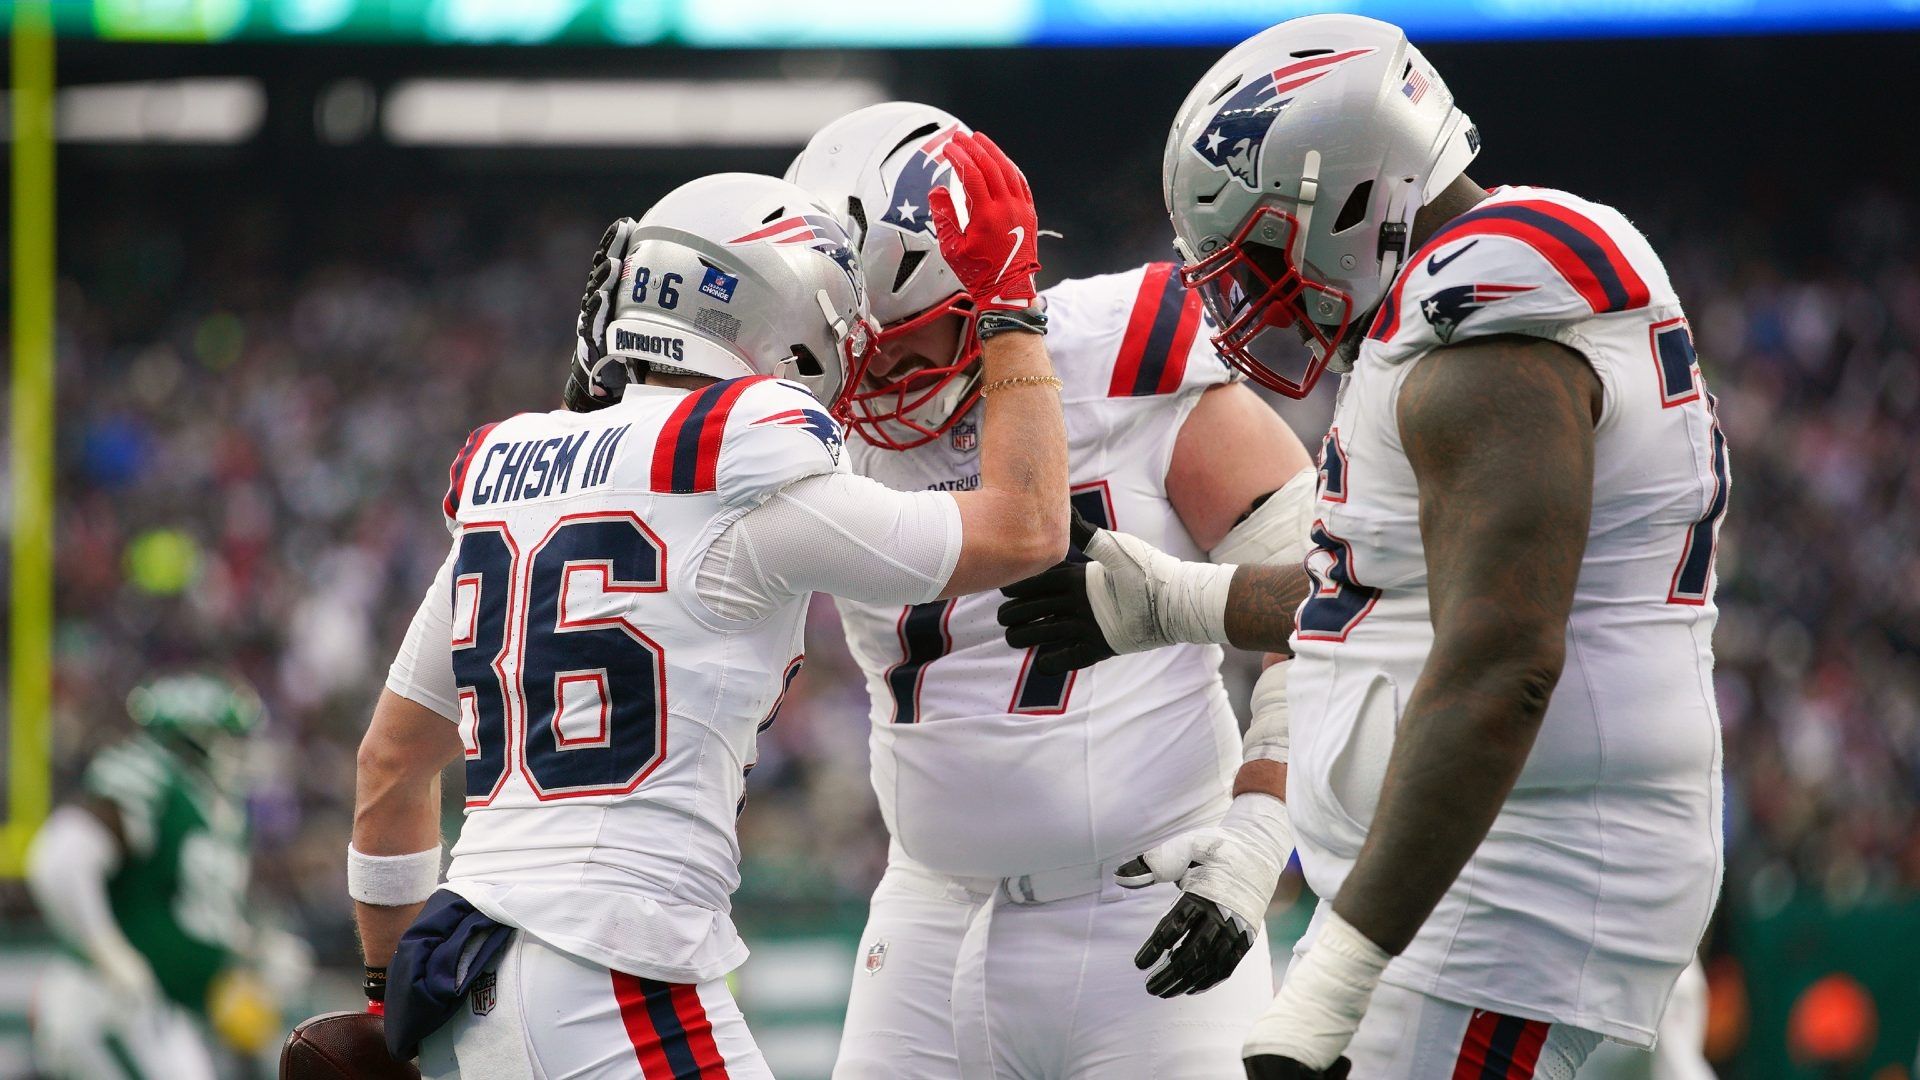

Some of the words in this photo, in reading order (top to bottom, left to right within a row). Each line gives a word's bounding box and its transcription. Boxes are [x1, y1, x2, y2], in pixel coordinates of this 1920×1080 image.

[632, 266, 684, 310] 86
[615, 327, 684, 361] PATRIOTS
[954, 433, 976, 450] NFL
[472, 430, 590, 505] CHISM
[580, 422, 633, 489] III
[927, 472, 981, 492] PATRIO
[452, 510, 668, 807] 86
[474, 987, 497, 1012] NFL
